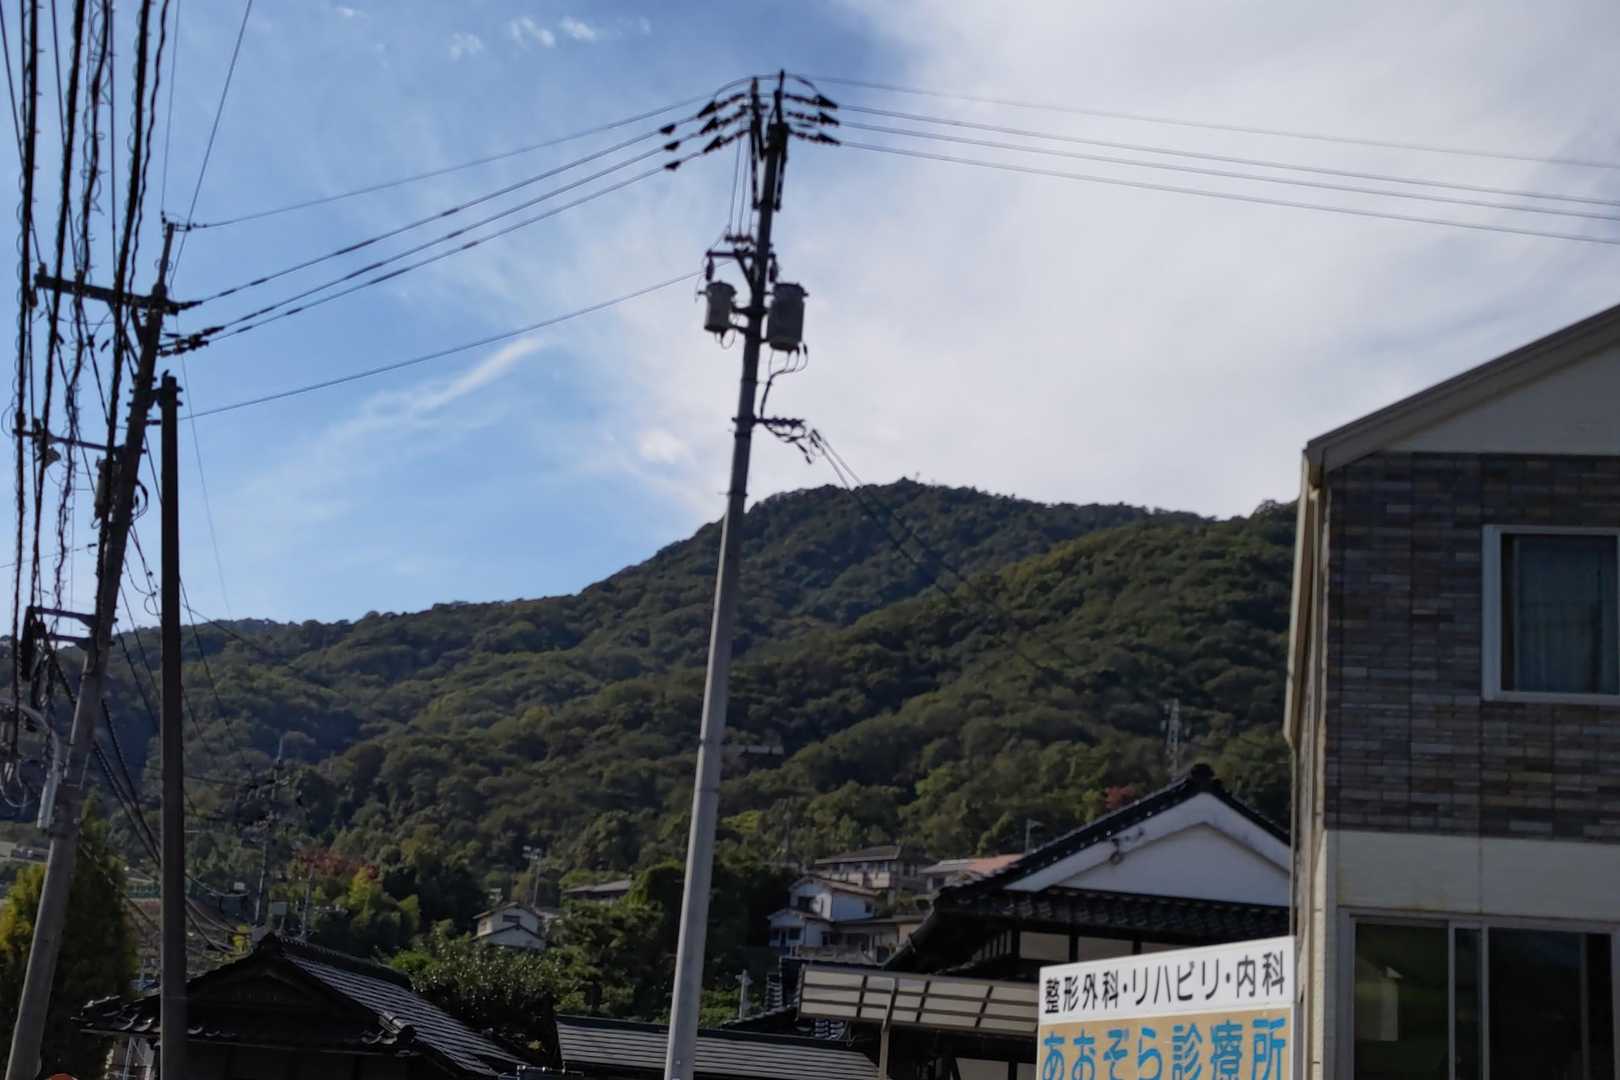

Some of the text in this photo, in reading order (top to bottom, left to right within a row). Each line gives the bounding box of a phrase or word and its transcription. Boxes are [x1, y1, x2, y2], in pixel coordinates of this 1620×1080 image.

[1044, 950, 1285, 1014] 整形外科・リハビリ・内科
